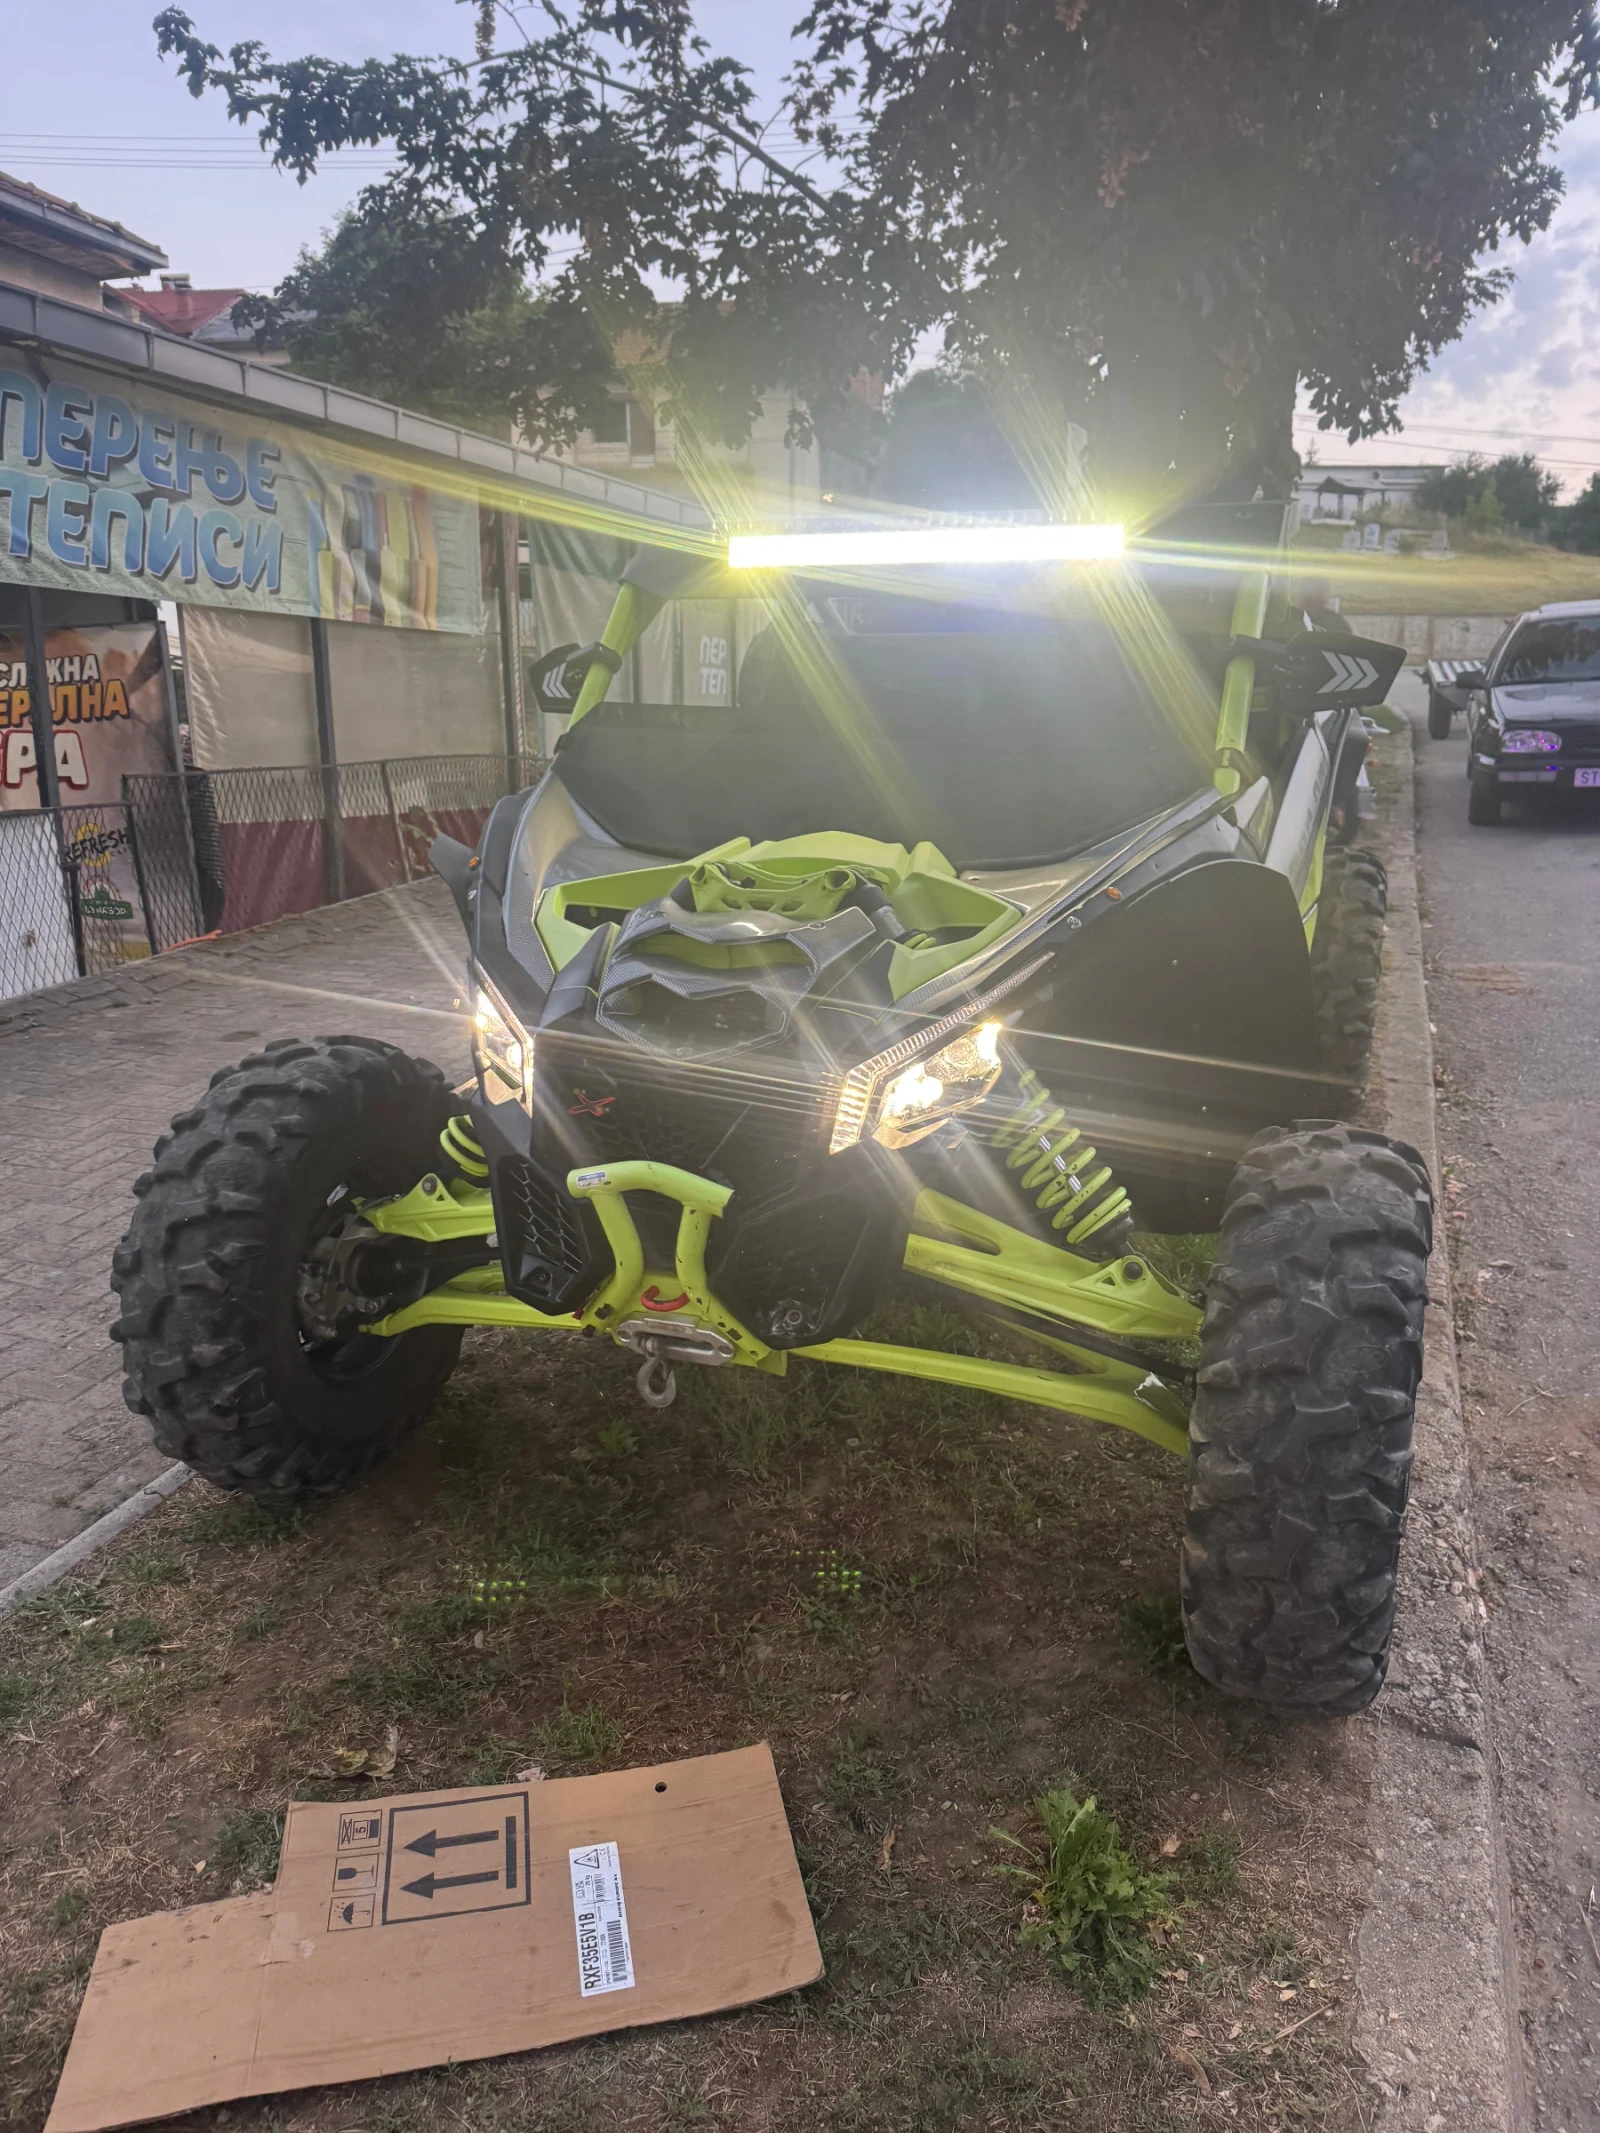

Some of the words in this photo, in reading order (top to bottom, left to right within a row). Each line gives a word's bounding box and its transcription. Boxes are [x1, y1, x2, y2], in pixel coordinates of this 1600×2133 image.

[0, 368, 281, 513] ПЕРЕЊЕ
[0, 467, 283, 594] ТЕПИСИ
[0, 653, 101, 688] СЛЖНА
[700, 636, 727, 664] ПЕР
[700, 667, 727, 695] ТЕП
[0, 678, 131, 729] ЕРЛНА
[0, 729, 89, 790] РА
[1581, 771, 1600, 785] ST
[355, 1826, 366, 1834] 5
[578, 1912, 601, 1989] RXF35E5V1B
